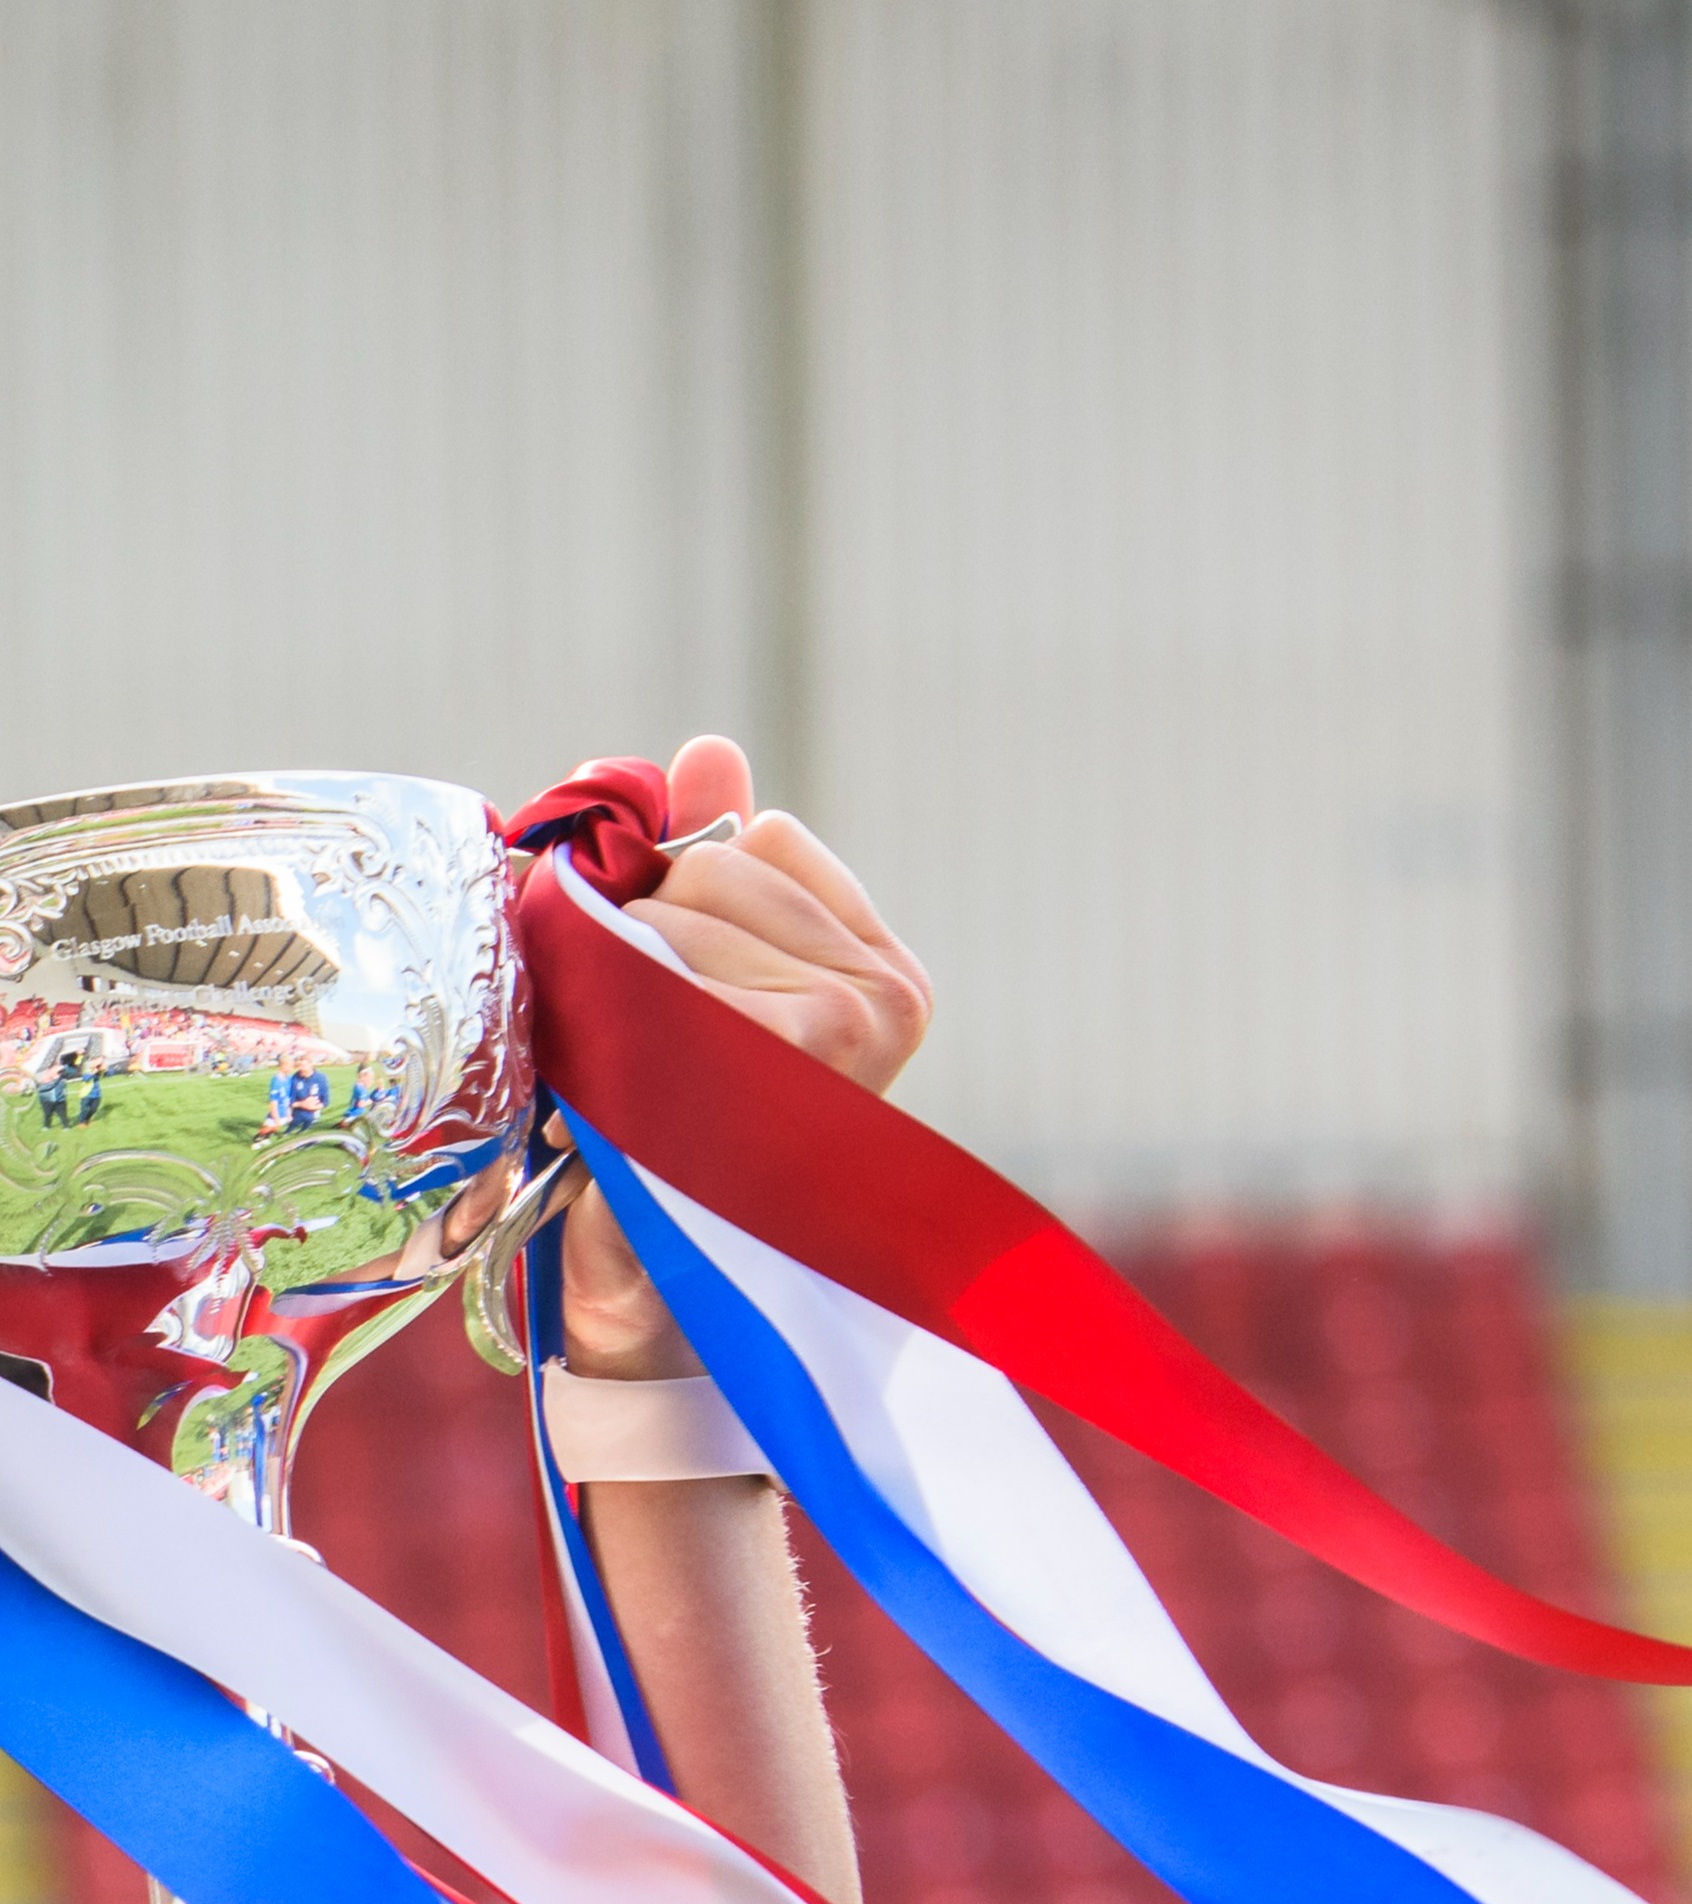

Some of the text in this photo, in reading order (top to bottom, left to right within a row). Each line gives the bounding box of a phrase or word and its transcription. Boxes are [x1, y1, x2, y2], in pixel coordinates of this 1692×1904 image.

[52, 933, 143, 961] Glasgow
[144, 913, 234, 947] Football
[192, 978, 296, 1006] Challenge
